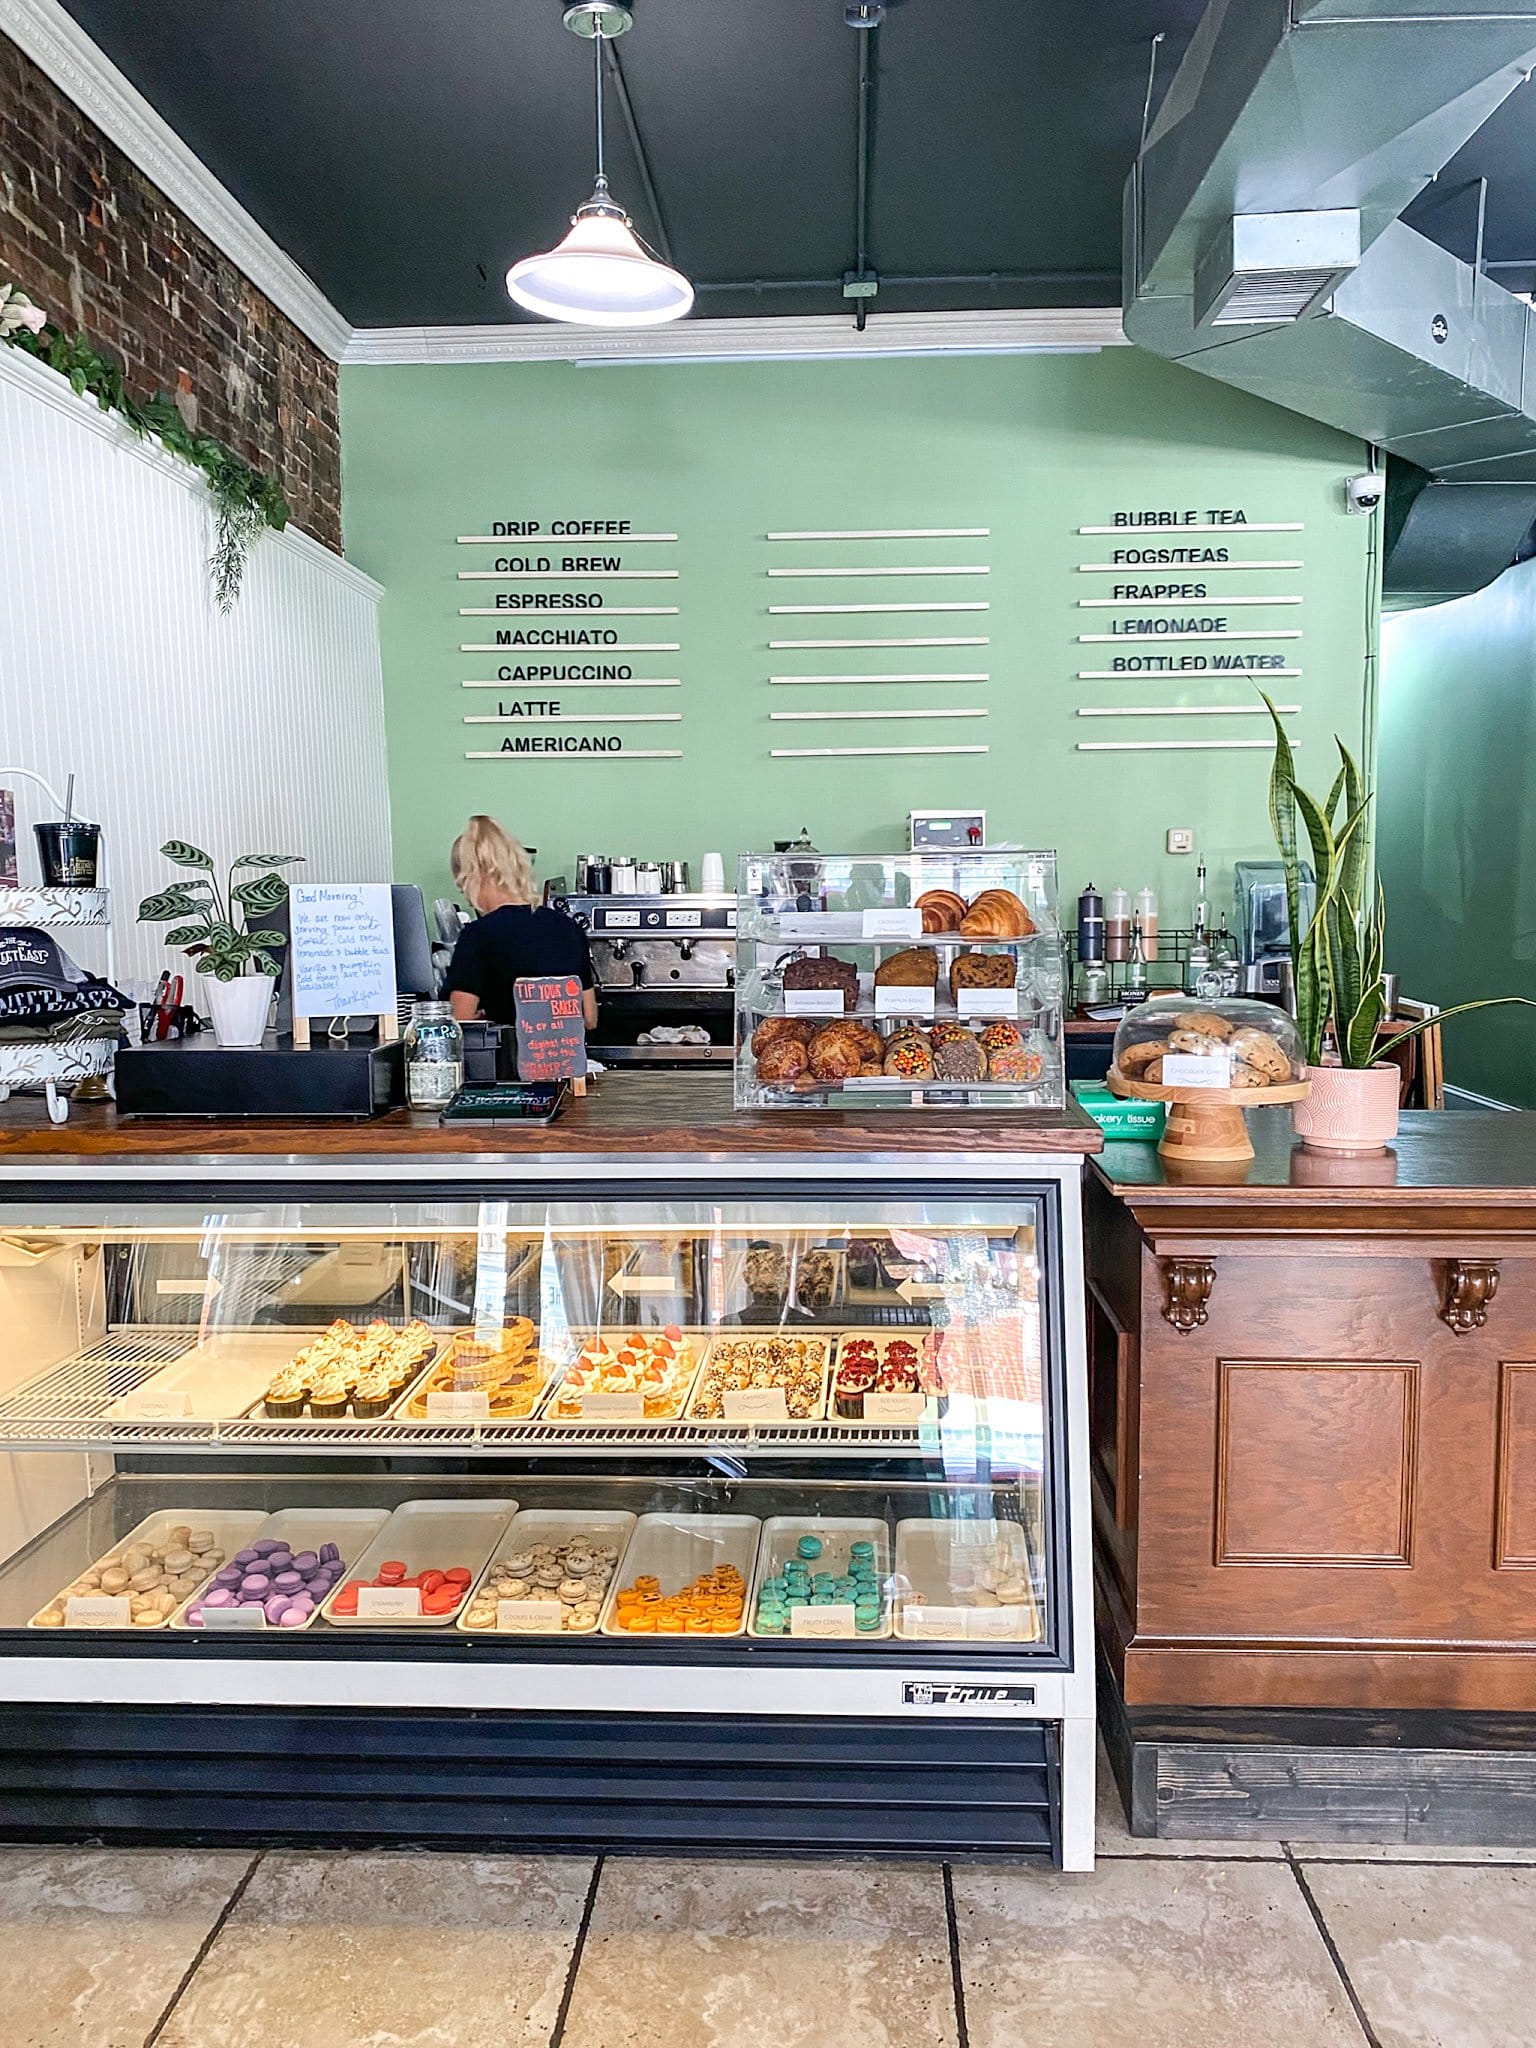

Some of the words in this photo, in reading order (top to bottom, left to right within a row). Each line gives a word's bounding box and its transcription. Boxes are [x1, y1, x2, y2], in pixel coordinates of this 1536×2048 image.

[1114, 511, 1197, 526] BUBBLE
[1206, 510, 1247, 525] TEA
[492, 521, 540, 537] DRIP
[551, 520, 631, 535] COFFEE
[1113, 548, 1229, 564] FOGS/TEAS
[495, 557, 551, 572] COLD
[562, 557, 621, 572] BREW
[1113, 584, 1207, 599] FRAPPES
[495, 593, 603, 609] ESPRESSO
[1113, 618, 1227, 634] LEMONADE
[496, 630, 618, 645] MACCHIATO
[1113, 656, 1207, 672] BOTTLED
[1213, 655, 1286, 670] WATER
[498, 665, 632, 681] CAPPUCCINO
[498, 701, 561, 716] LATTE
[501, 736, 622, 752] AMERICANO
[515, 983, 535, 999] TIP
[538, 983, 562, 1001] YOUR
[550, 1000, 580, 1015] BAKER
[1094, 1113, 1124, 1125] akery
[1127, 1112, 1156, 1125] tissue
